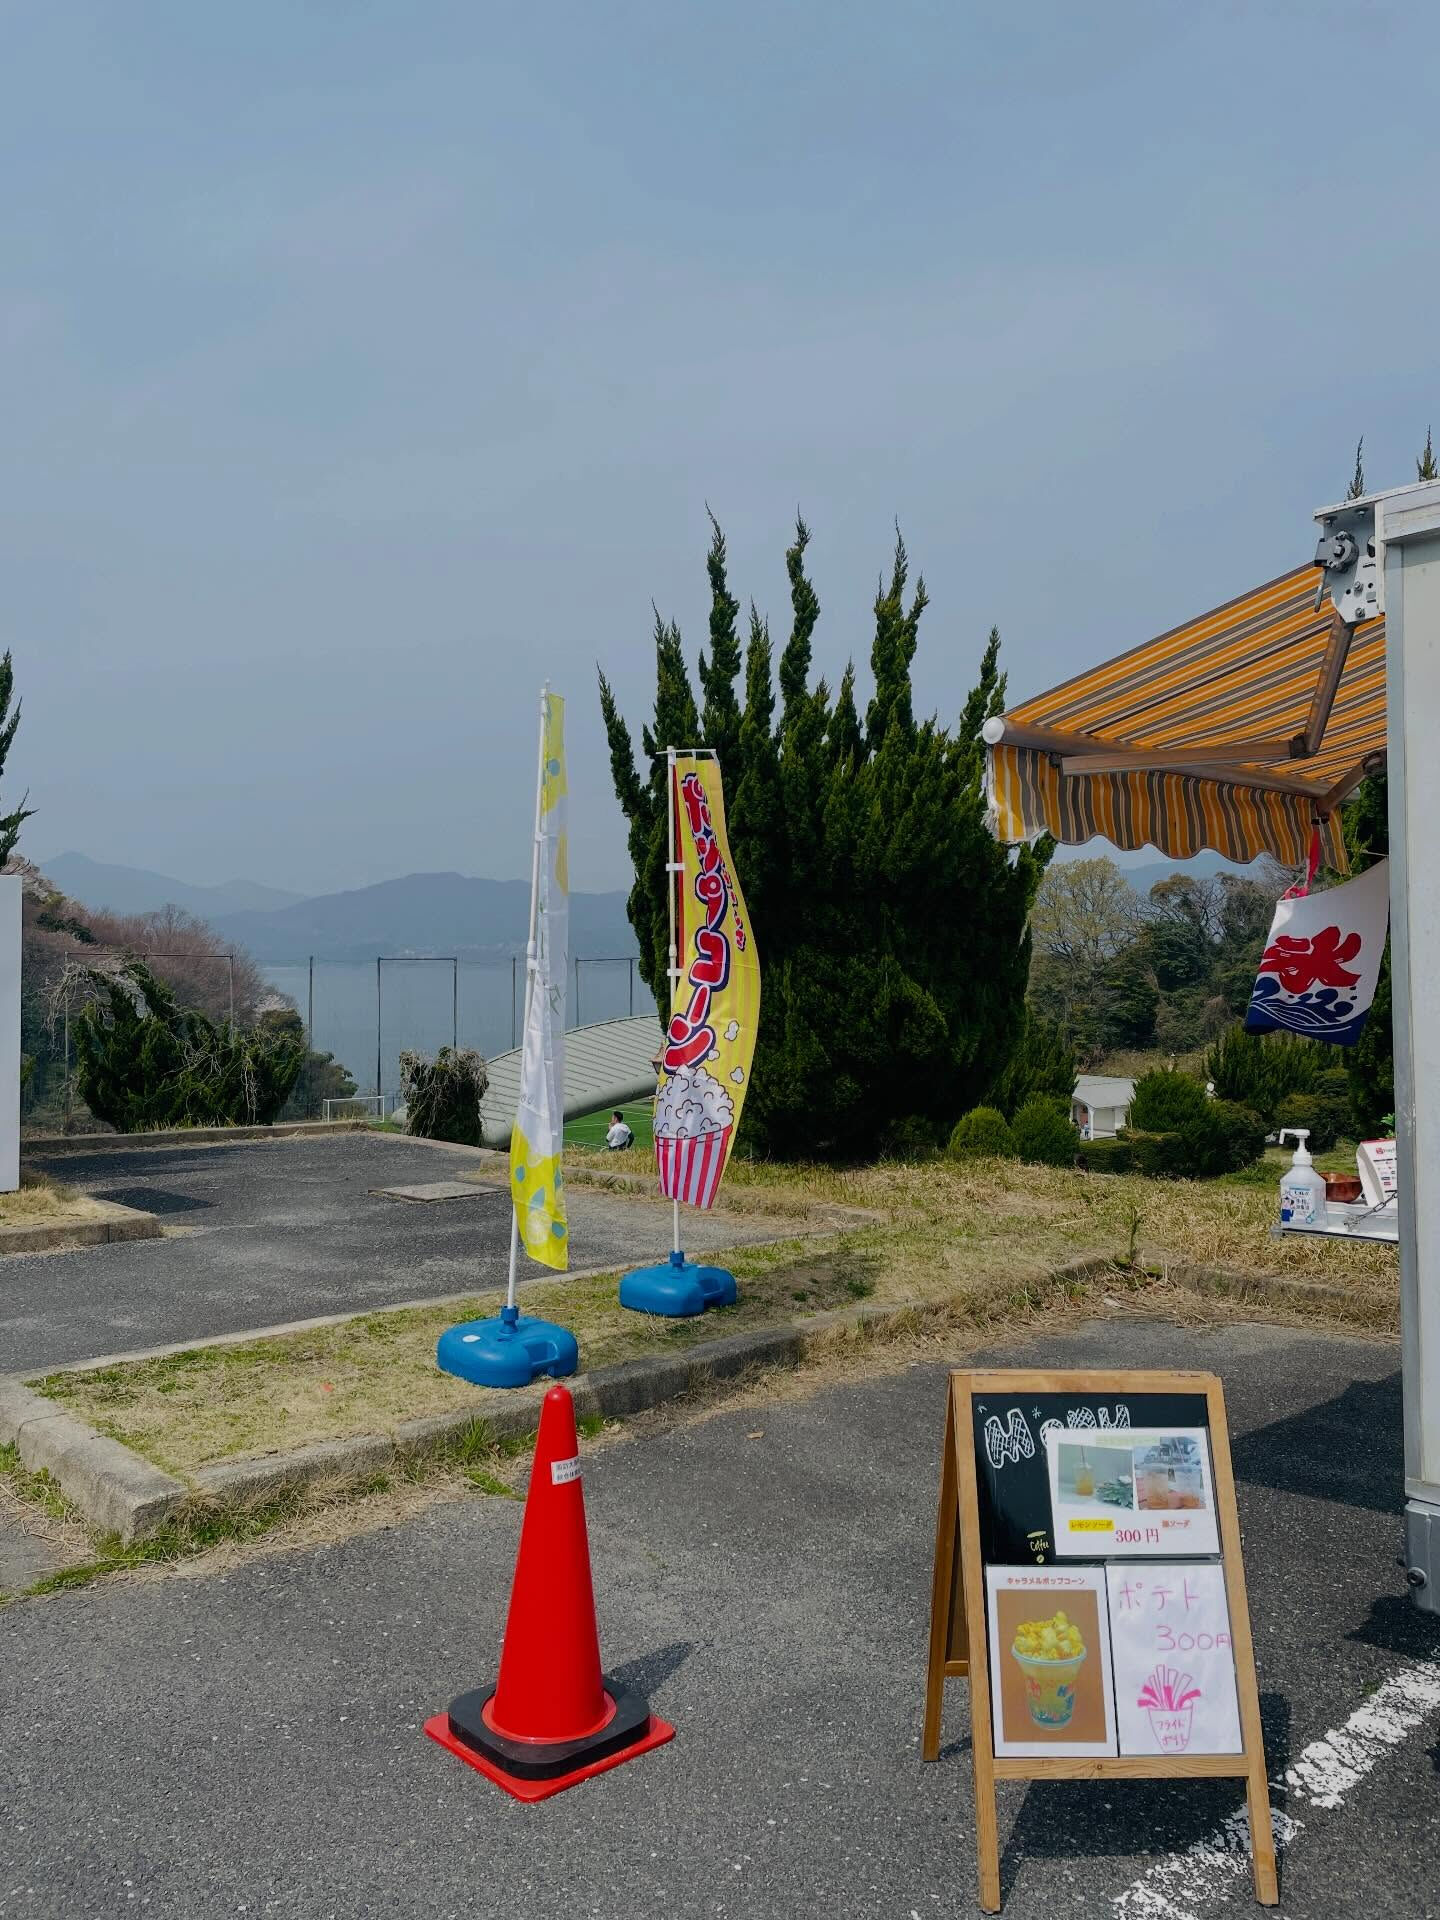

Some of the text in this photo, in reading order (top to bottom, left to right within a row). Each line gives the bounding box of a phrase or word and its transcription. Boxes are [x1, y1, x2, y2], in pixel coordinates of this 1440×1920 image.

[664, 772, 730, 1074] ポップコーン
[1259, 926, 1362, 994] 氷
[1007, 1576, 1086, 1586] キャラメルポップコーン
[1119, 1577, 1201, 1611] ポテト
[1155, 1625, 1231, 1651] 300円
